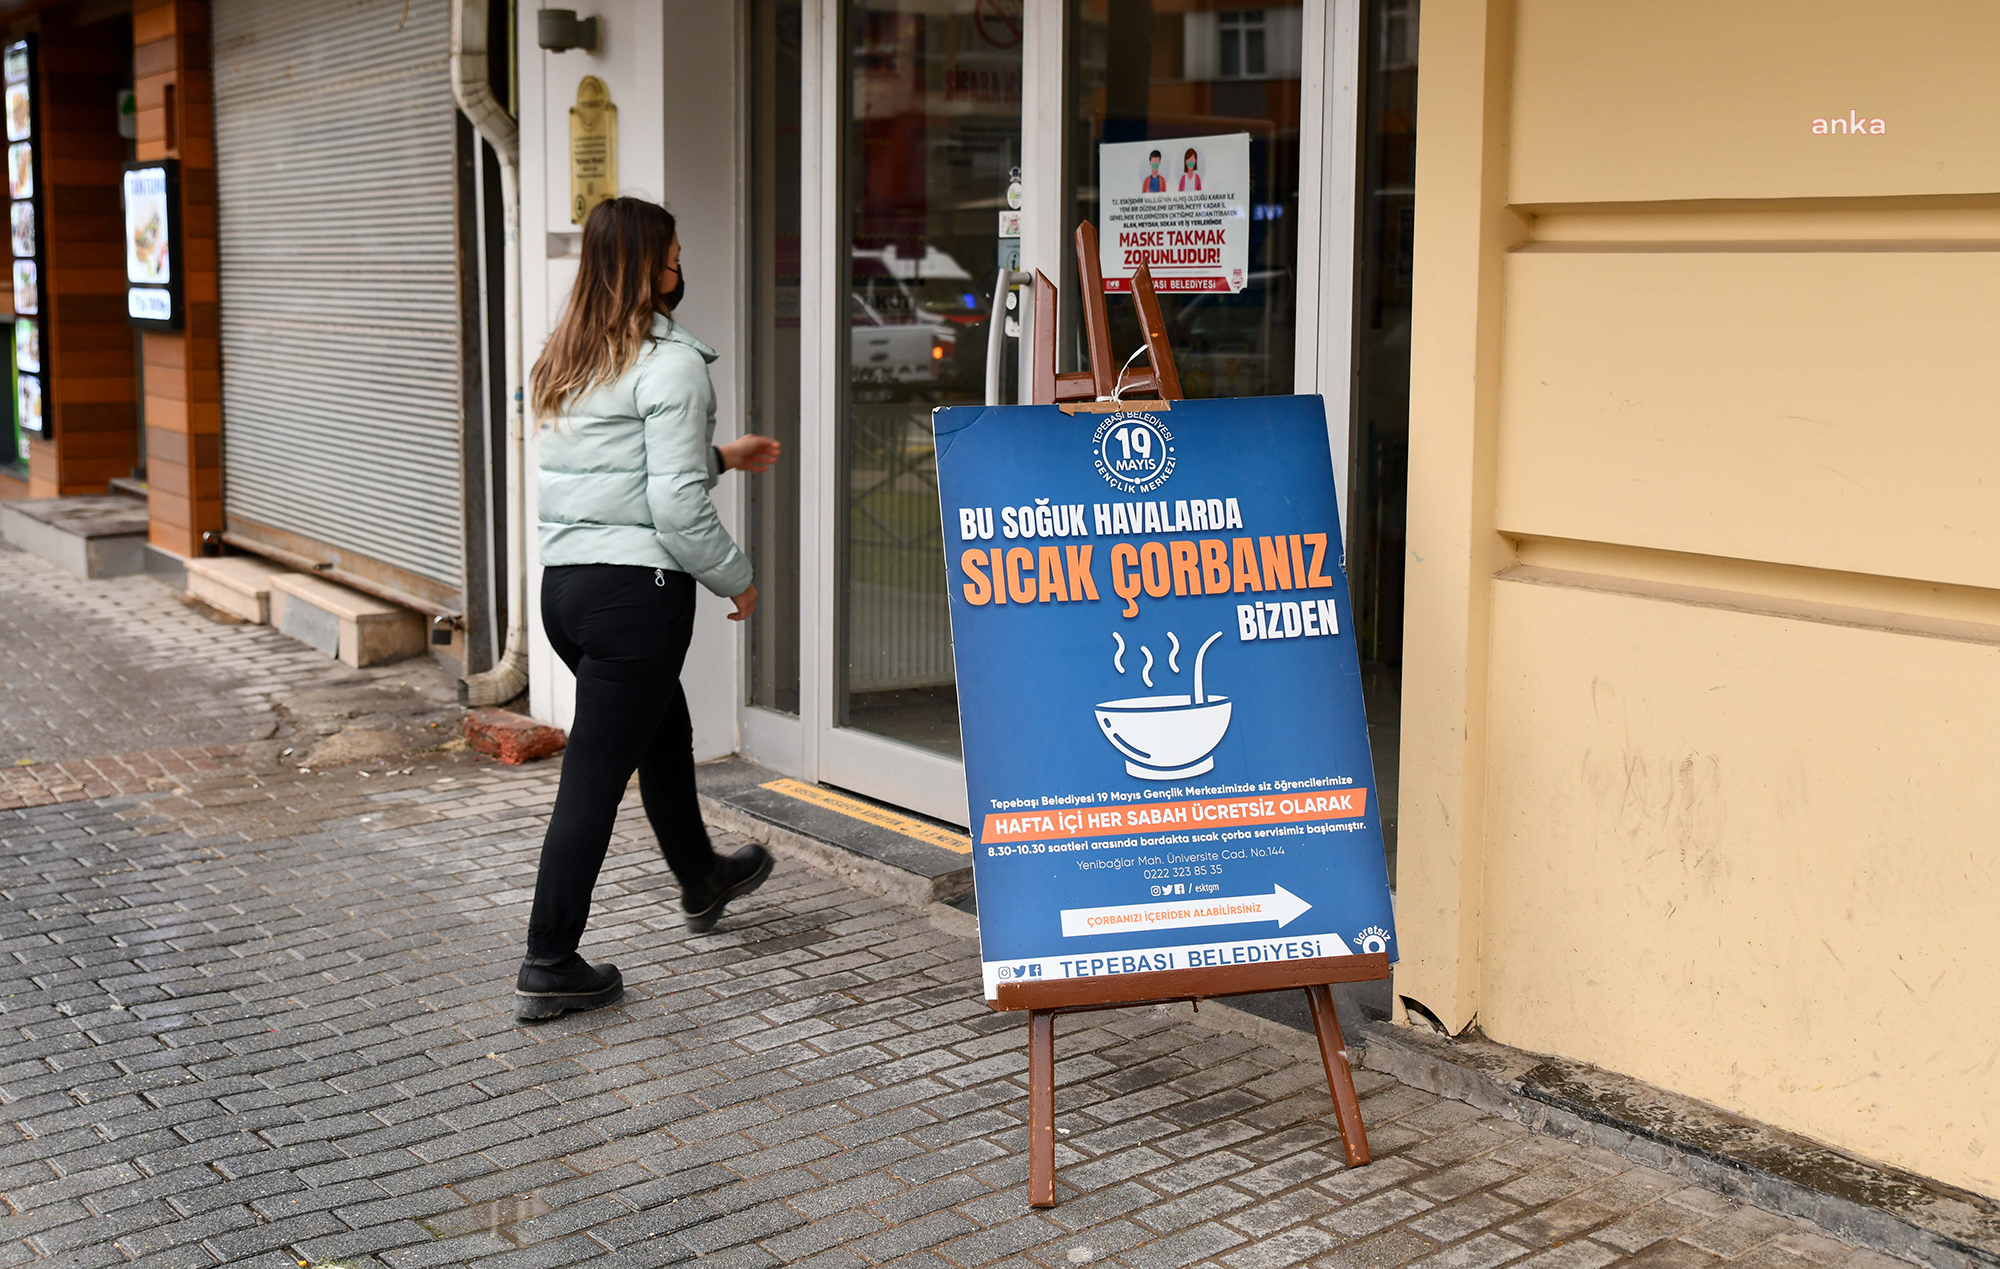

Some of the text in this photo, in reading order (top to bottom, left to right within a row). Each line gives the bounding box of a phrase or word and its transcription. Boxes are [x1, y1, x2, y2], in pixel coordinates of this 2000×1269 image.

[1119, 229, 1226, 247] MASKE TAKMAK
[1124, 248, 1221, 265] ZORUNLUDUR!
[1115, 427, 1151, 459] 19
[1116, 459, 1156, 471] MAYIS
[959, 497, 1243, 540] BU SOĞUK HAVALARDA
[960, 532, 1333, 618] SICAK ÇORBANIZ
[991, 775, 1353, 810] Tepebaşı Belediyesi 19 Mayıs Gençlik Merkezimizde siz öğrencilerimize
[995, 794, 1353, 835] HAFTA İÇİ HER SABAH ÜCRETSİZ OLARAK
[988, 821, 1366, 857] 8.30-10.30 saatleri arasında bardakta sıcak çorba servisimiz başlamıştır.
[1076, 846, 1285, 871] Yenibağlar Mah. Üniversite Cad. No.144
[1143, 864, 1223, 880] 0222 323 85 35
[1086, 903, 1261, 928] ÇORBANIZI İÇERİDEN ALABİLİRSİNİZ
[1353, 925, 1391, 945] ücretsiz
